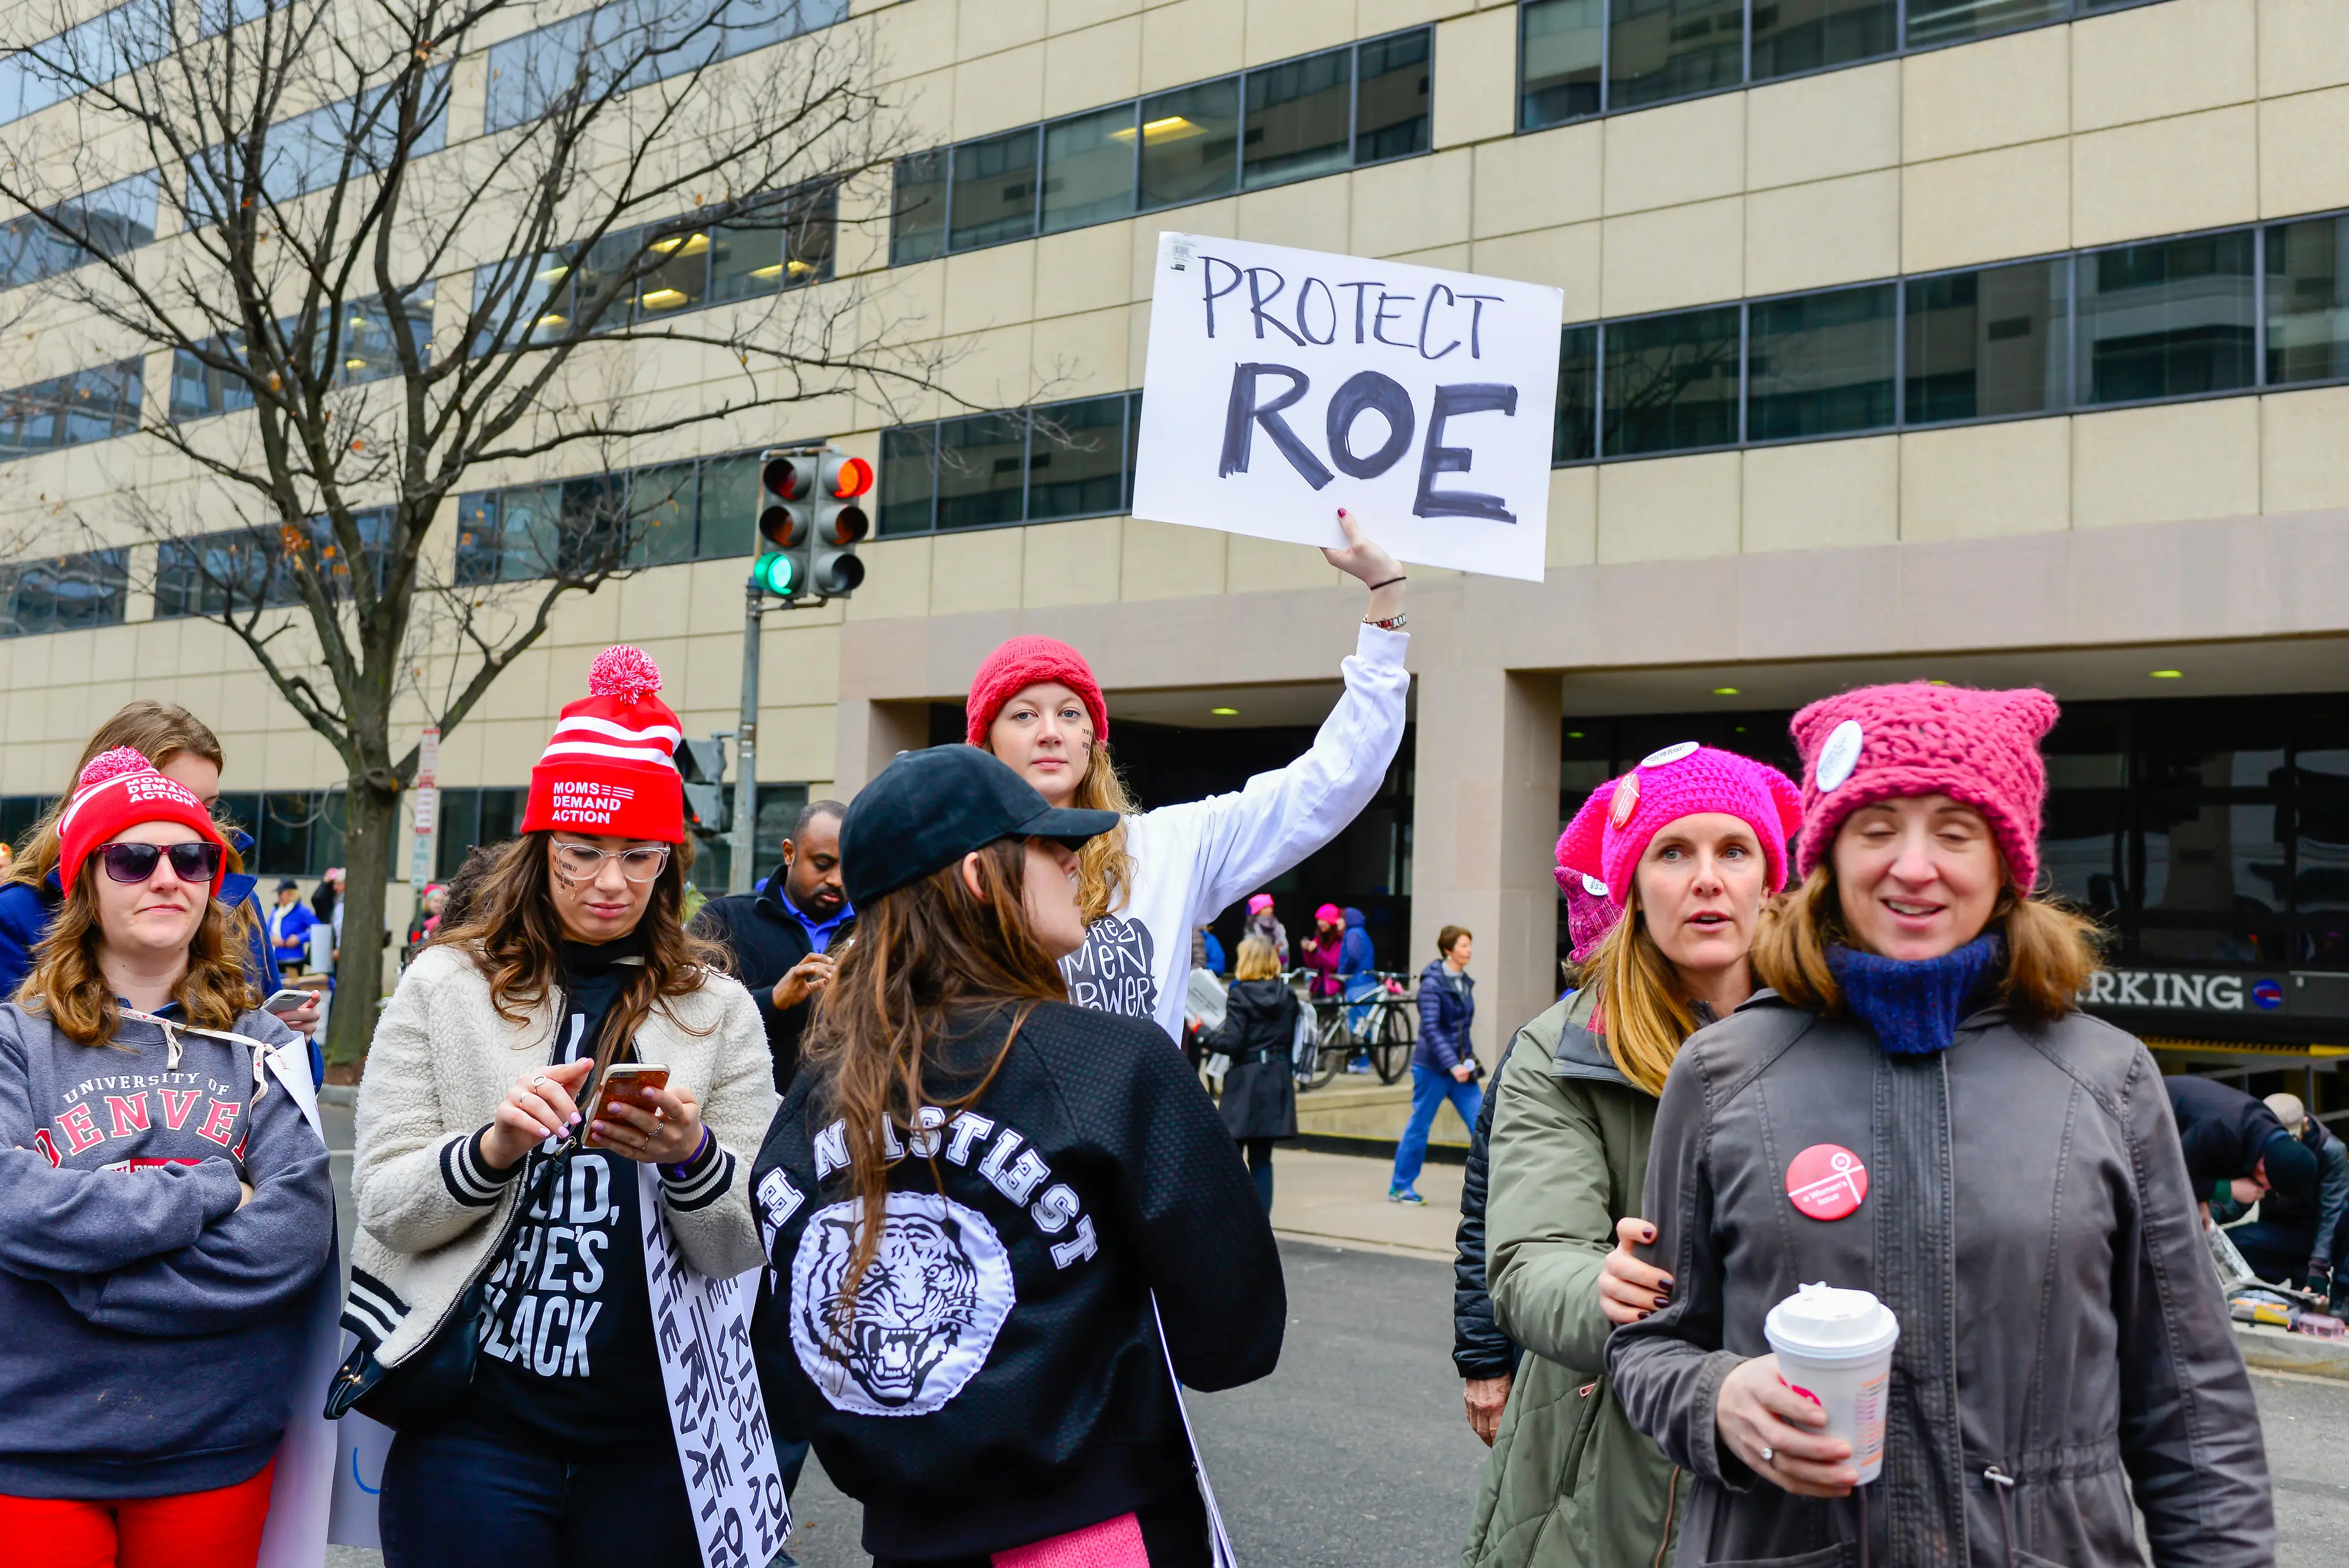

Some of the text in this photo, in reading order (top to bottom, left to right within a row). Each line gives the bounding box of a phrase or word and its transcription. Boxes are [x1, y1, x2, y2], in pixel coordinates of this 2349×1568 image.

[1198, 256, 1505, 360] PROTECT
[1218, 362, 1518, 524] ROE
[125, 776, 179, 787] MOMS
[130, 792, 195, 808] ACTION
[553, 781, 600, 795] MOMS
[553, 795, 622, 811] DEMAND
[551, 809, 610, 824] ACTION
[2075, 970, 2244, 1010] RKING
[564, 1013, 585, 1064] I
[63, 1072, 230, 1104] UNIVERSITY OF
[34, 1088, 248, 1170] ENVE
[524, 1154, 620, 1226] OD,
[646, 1200, 682, 1365] THE
[680, 1339, 735, 1498] RISE
[716, 1323, 774, 1558] WOMAN
[729, 1313, 770, 1457] RISE
[765, 1473, 794, 1545] OF
